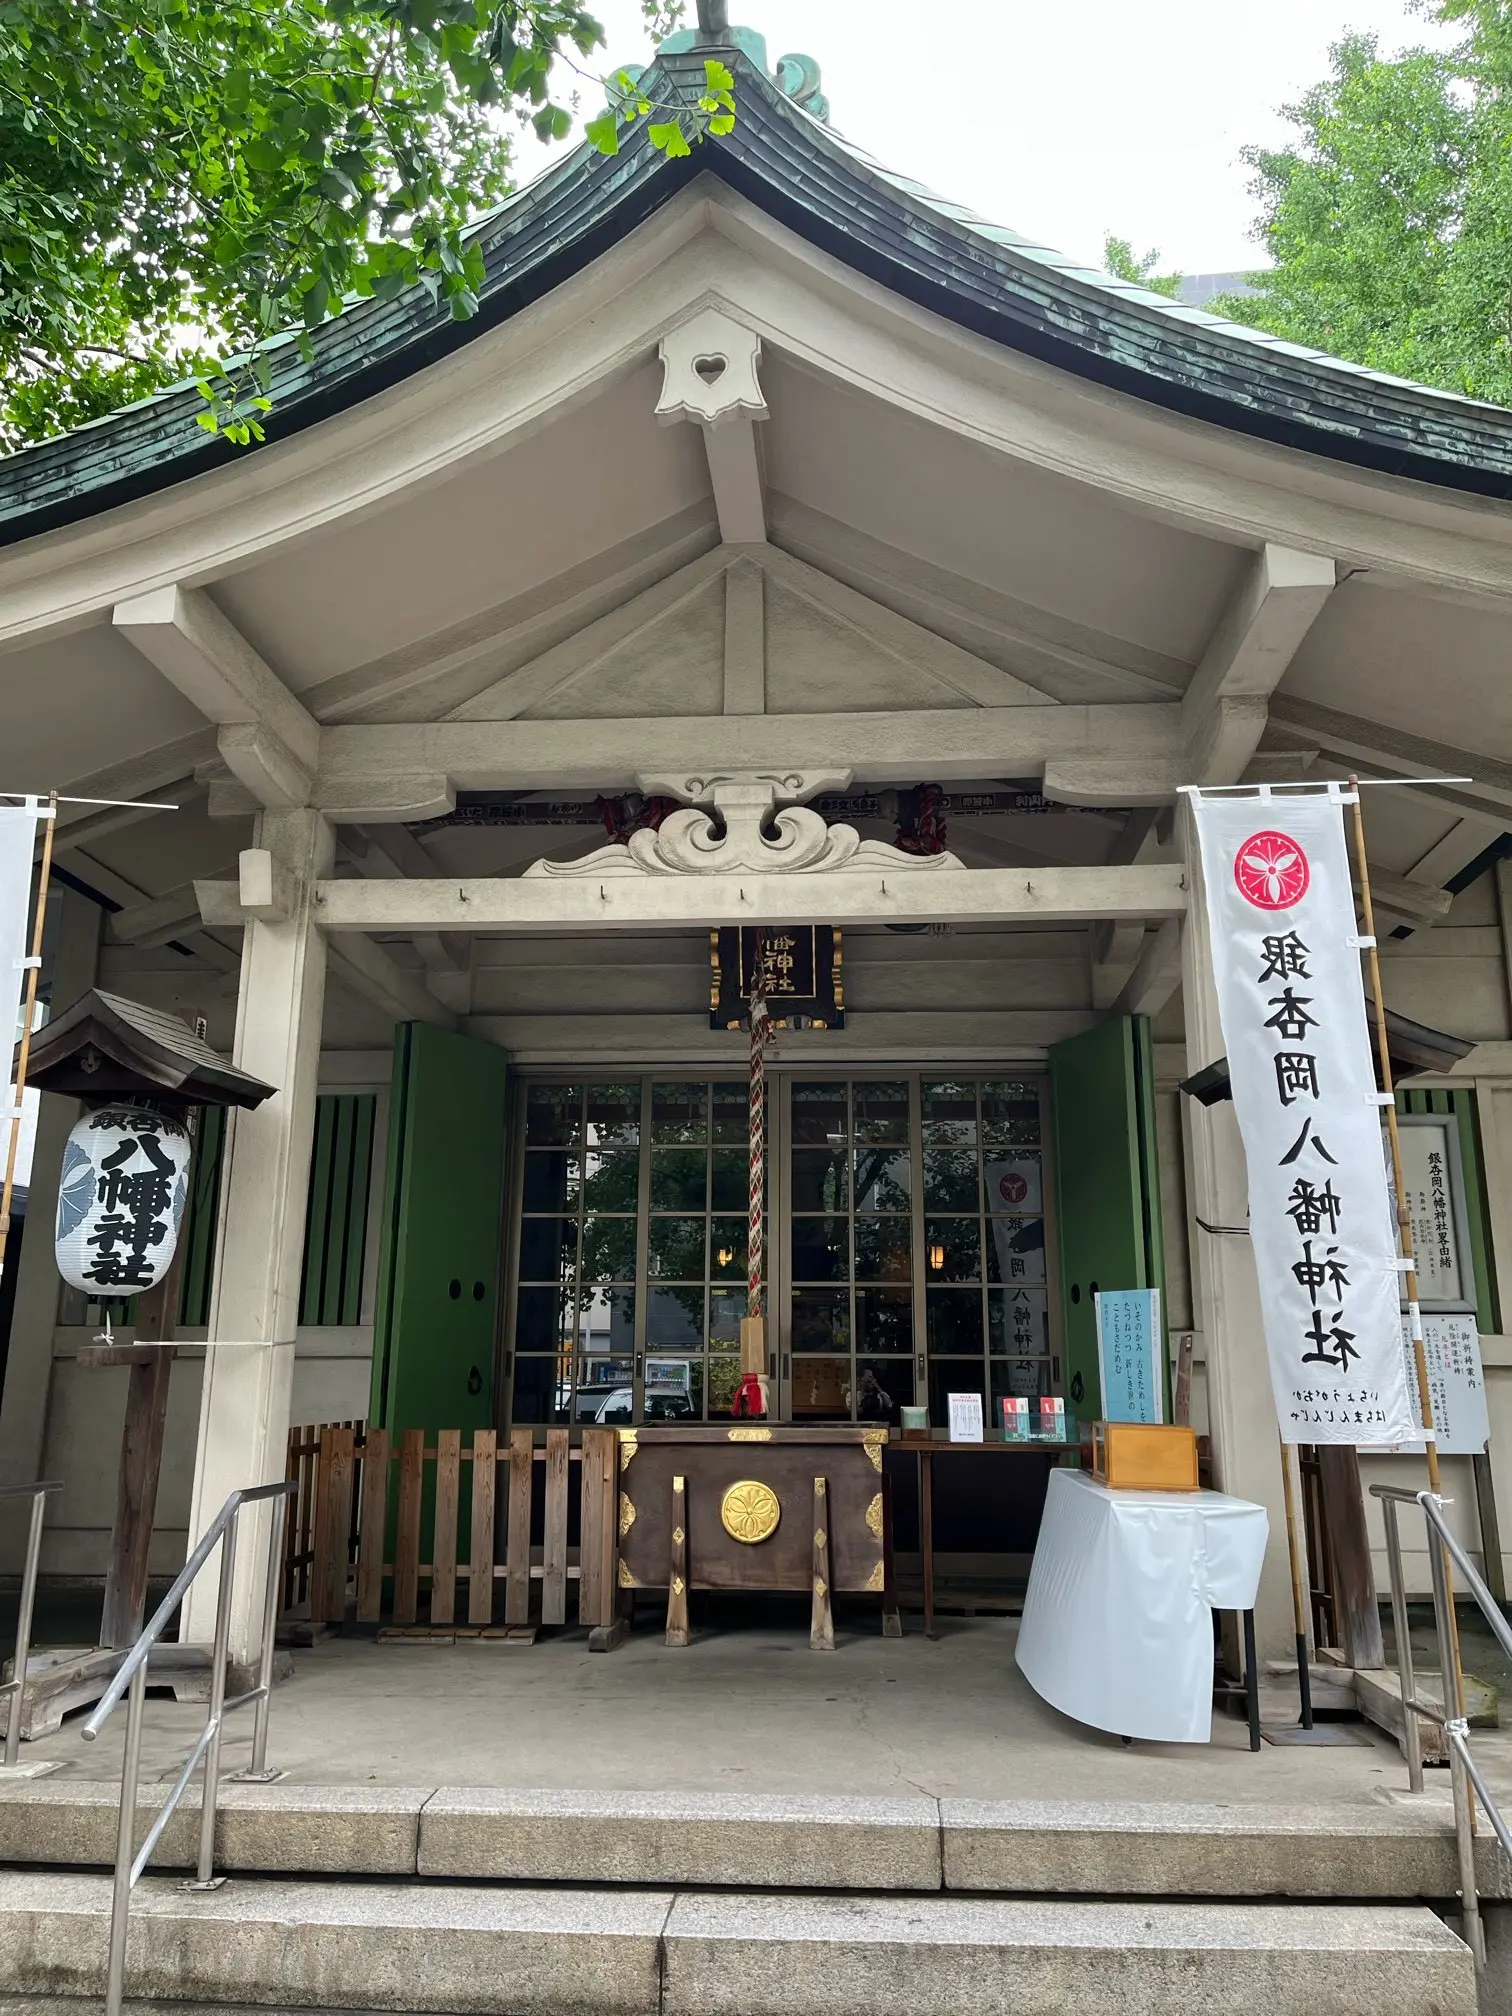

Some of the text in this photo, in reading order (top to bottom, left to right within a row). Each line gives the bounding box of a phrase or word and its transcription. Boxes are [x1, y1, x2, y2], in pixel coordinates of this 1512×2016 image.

[82, 1133, 176, 1287] 八幡神社
[1113, 1303, 1122, 1375] こともさだめむ
[1124, 1301, 1132, 1352] たづねつつ
[1134, 1302, 1143, 1352] いそのかみ
